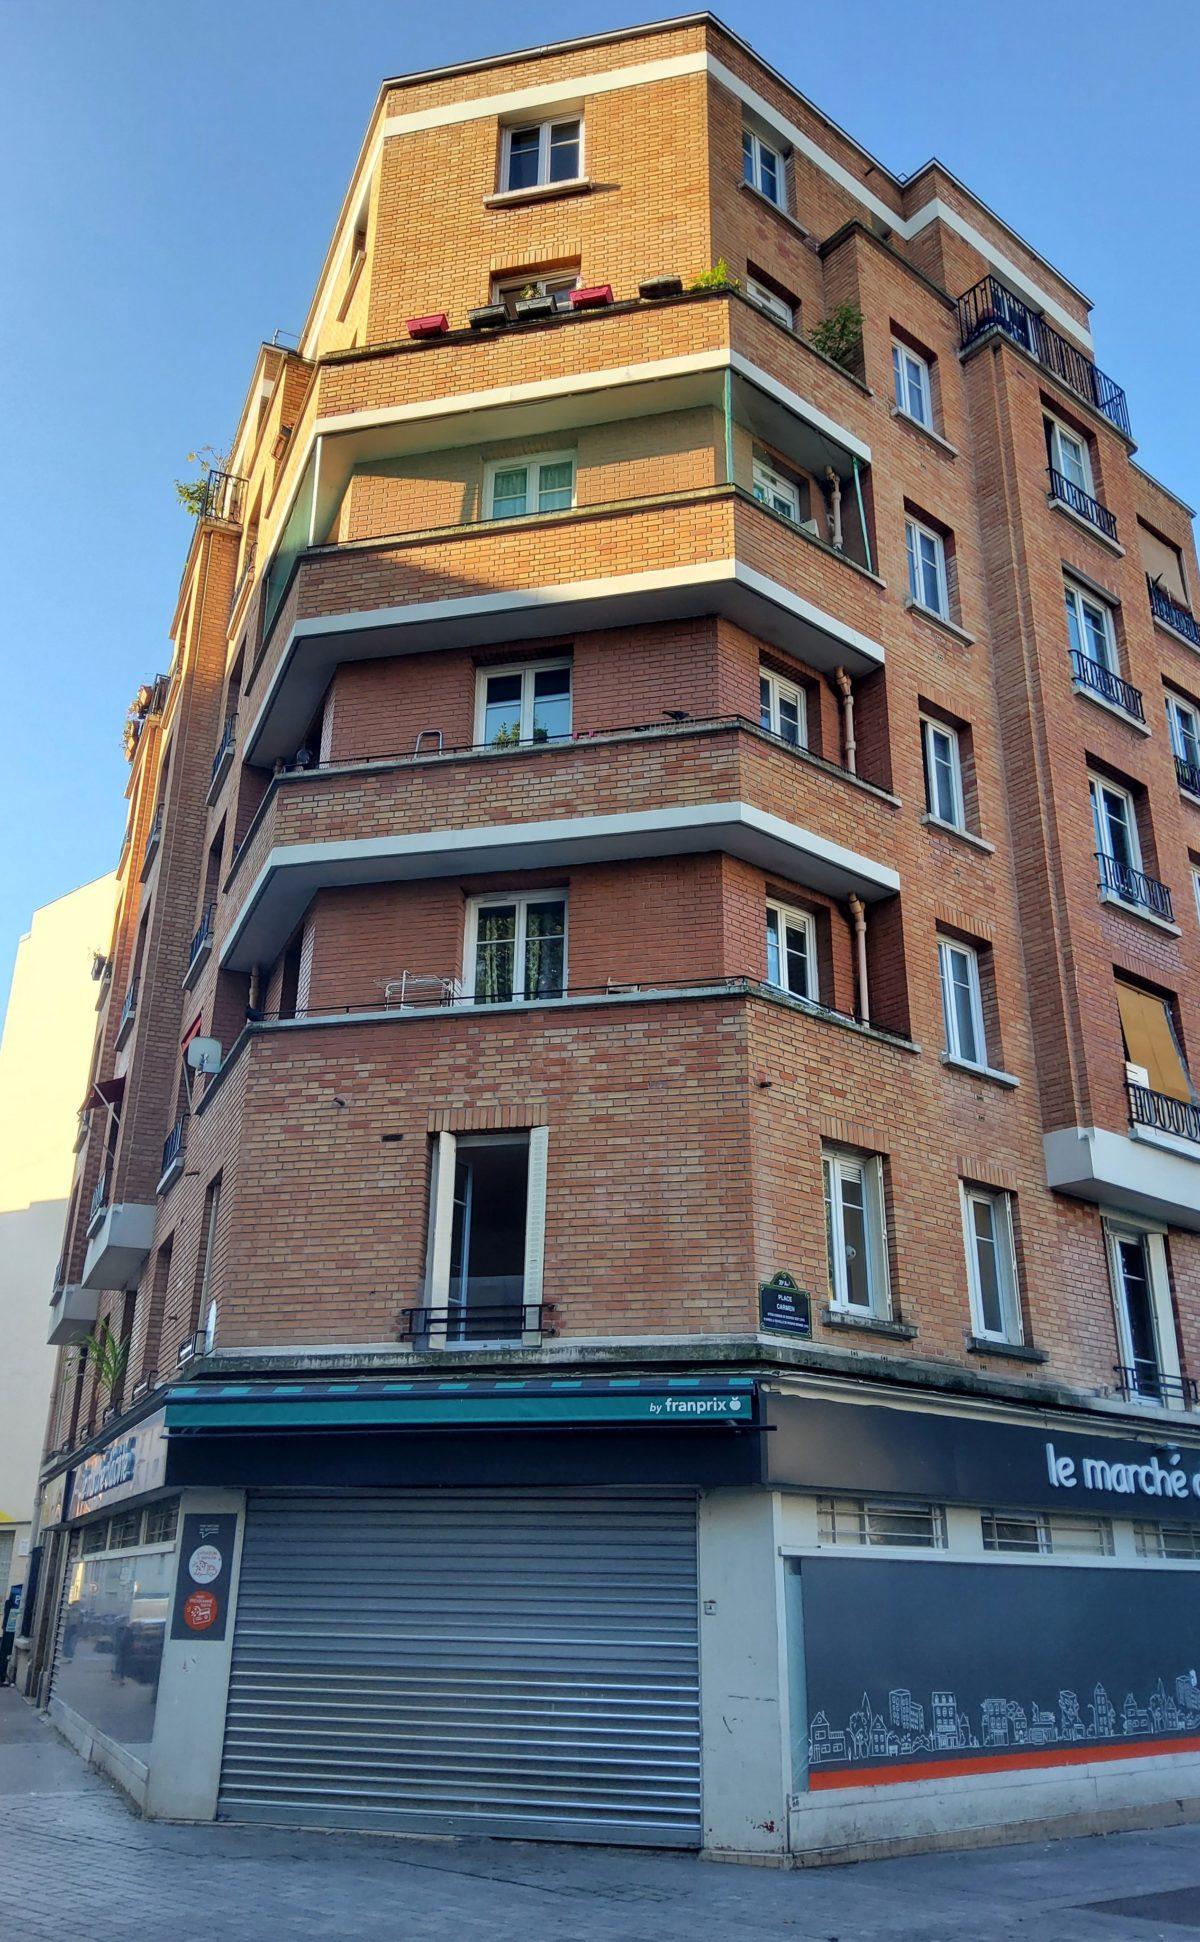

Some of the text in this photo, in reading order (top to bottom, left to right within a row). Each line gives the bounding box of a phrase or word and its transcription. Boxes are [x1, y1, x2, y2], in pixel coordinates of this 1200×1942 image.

[777, 1294, 792, 1302] PLACE
[776, 1303, 795, 1311] CARMEN
[649, 1397, 727, 1414] by franprix
[1046, 1442, 1078, 1487] le
[1082, 1453, 1189, 1498] marché
